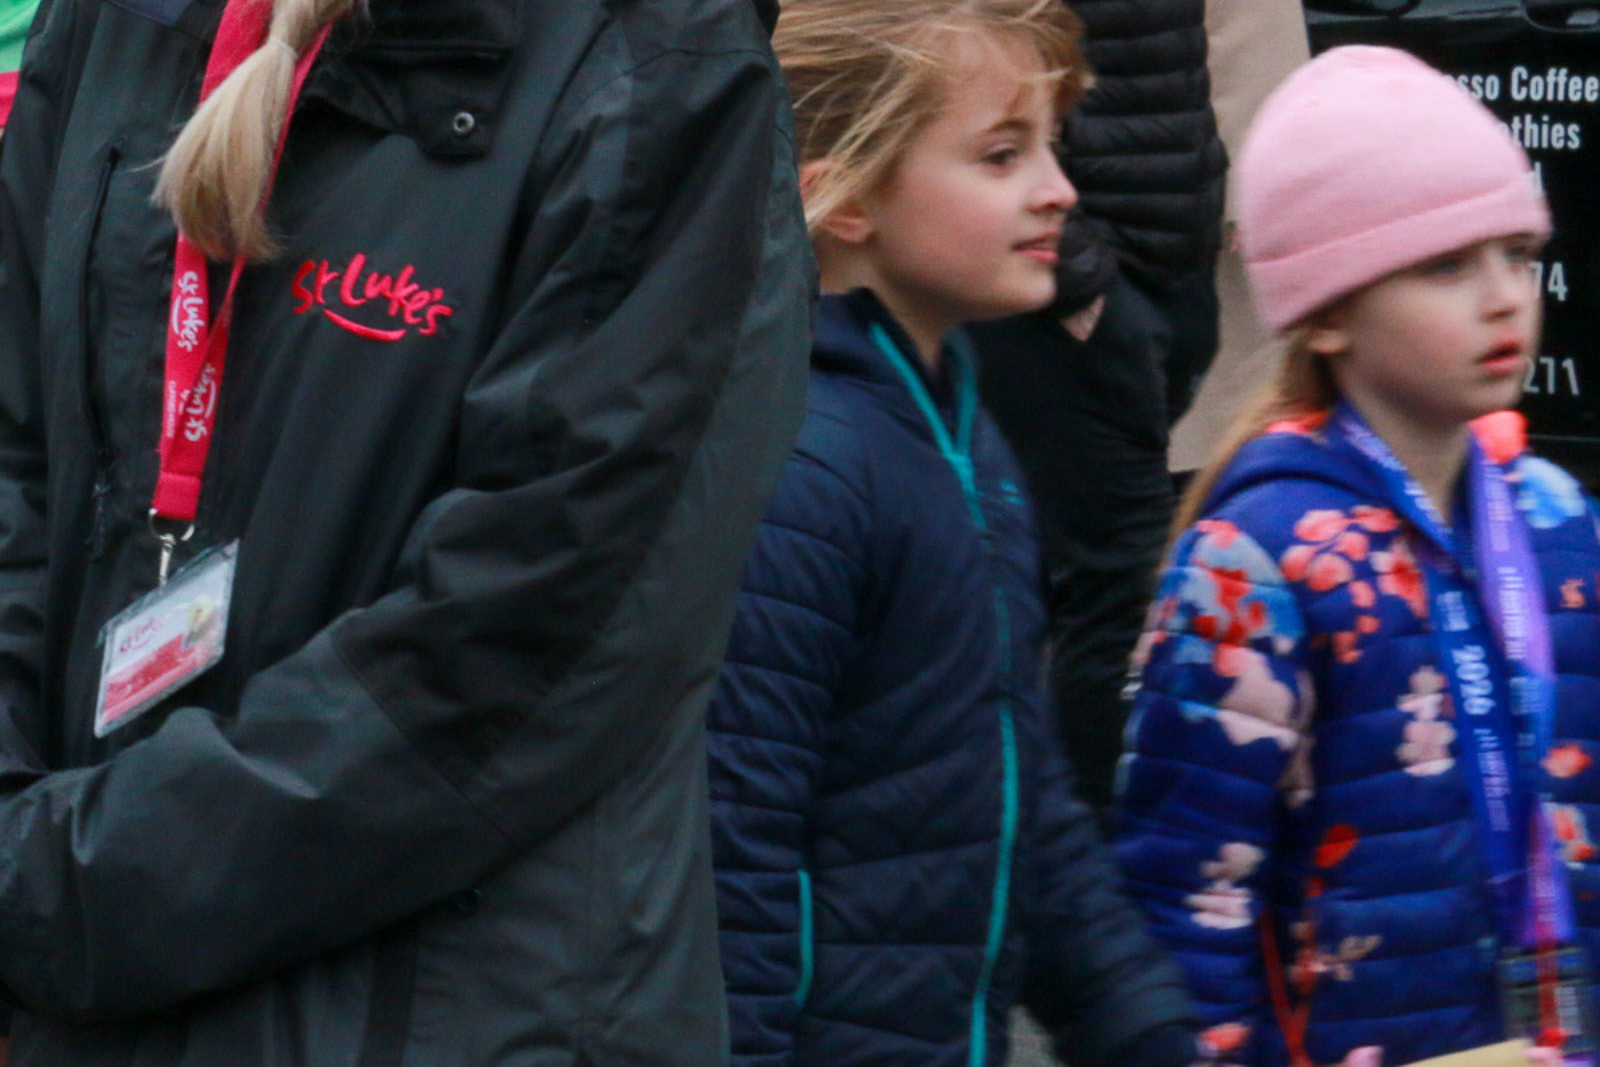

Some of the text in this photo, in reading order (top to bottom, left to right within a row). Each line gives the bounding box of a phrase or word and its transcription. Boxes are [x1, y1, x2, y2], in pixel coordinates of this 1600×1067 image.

[1511, 65, 1600, 103] Coffee
[340, 252, 454, 337] Luke's
[1452, 644, 1497, 716] 2026
